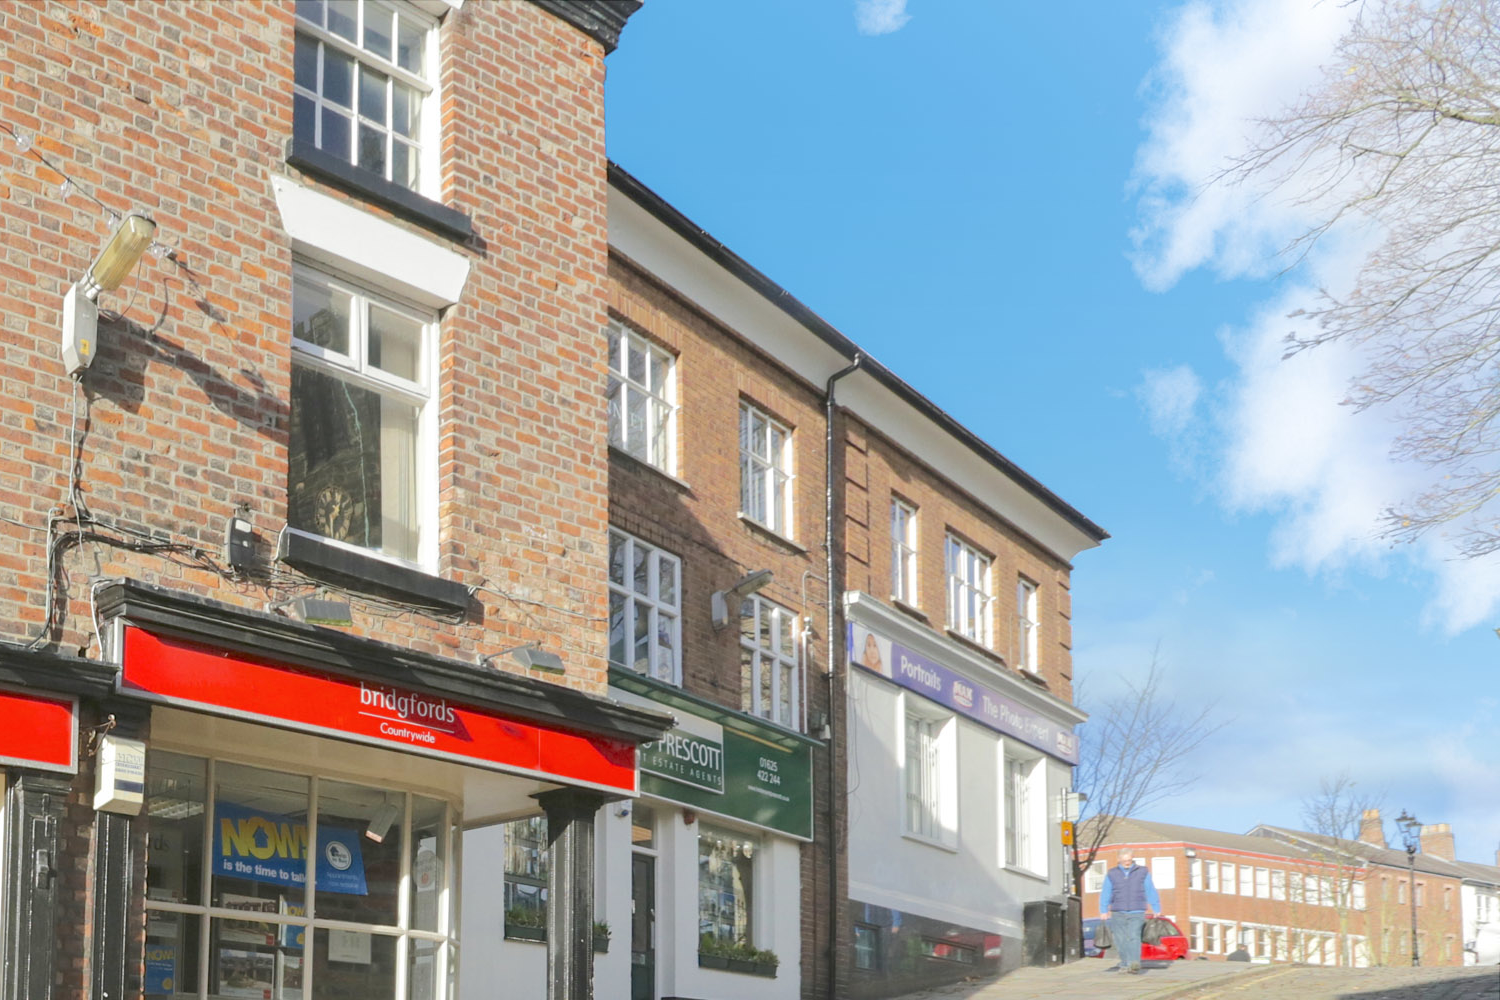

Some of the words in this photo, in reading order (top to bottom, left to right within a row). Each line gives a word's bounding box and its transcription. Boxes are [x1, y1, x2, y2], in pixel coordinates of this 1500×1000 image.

[901, 655, 941, 691] Portraits
[360, 681, 455, 723] bridgfords
[982, 695, 999, 718] The
[1000, 703, 1023, 730] Photo
[380, 722, 435, 743] Countrywide
[658, 733, 721, 770] PRESCOTT
[759, 757, 778, 772] 01625
[652, 756, 684, 774] ESTATE
[689, 768, 722, 786] AGENTS
[757, 770, 769, 783] 422
[769, 772, 781, 786] 244
[223, 859, 233, 870] is
[235, 859, 252, 873] the
[255, 864, 277, 878] time
[279, 869, 289, 880] to
